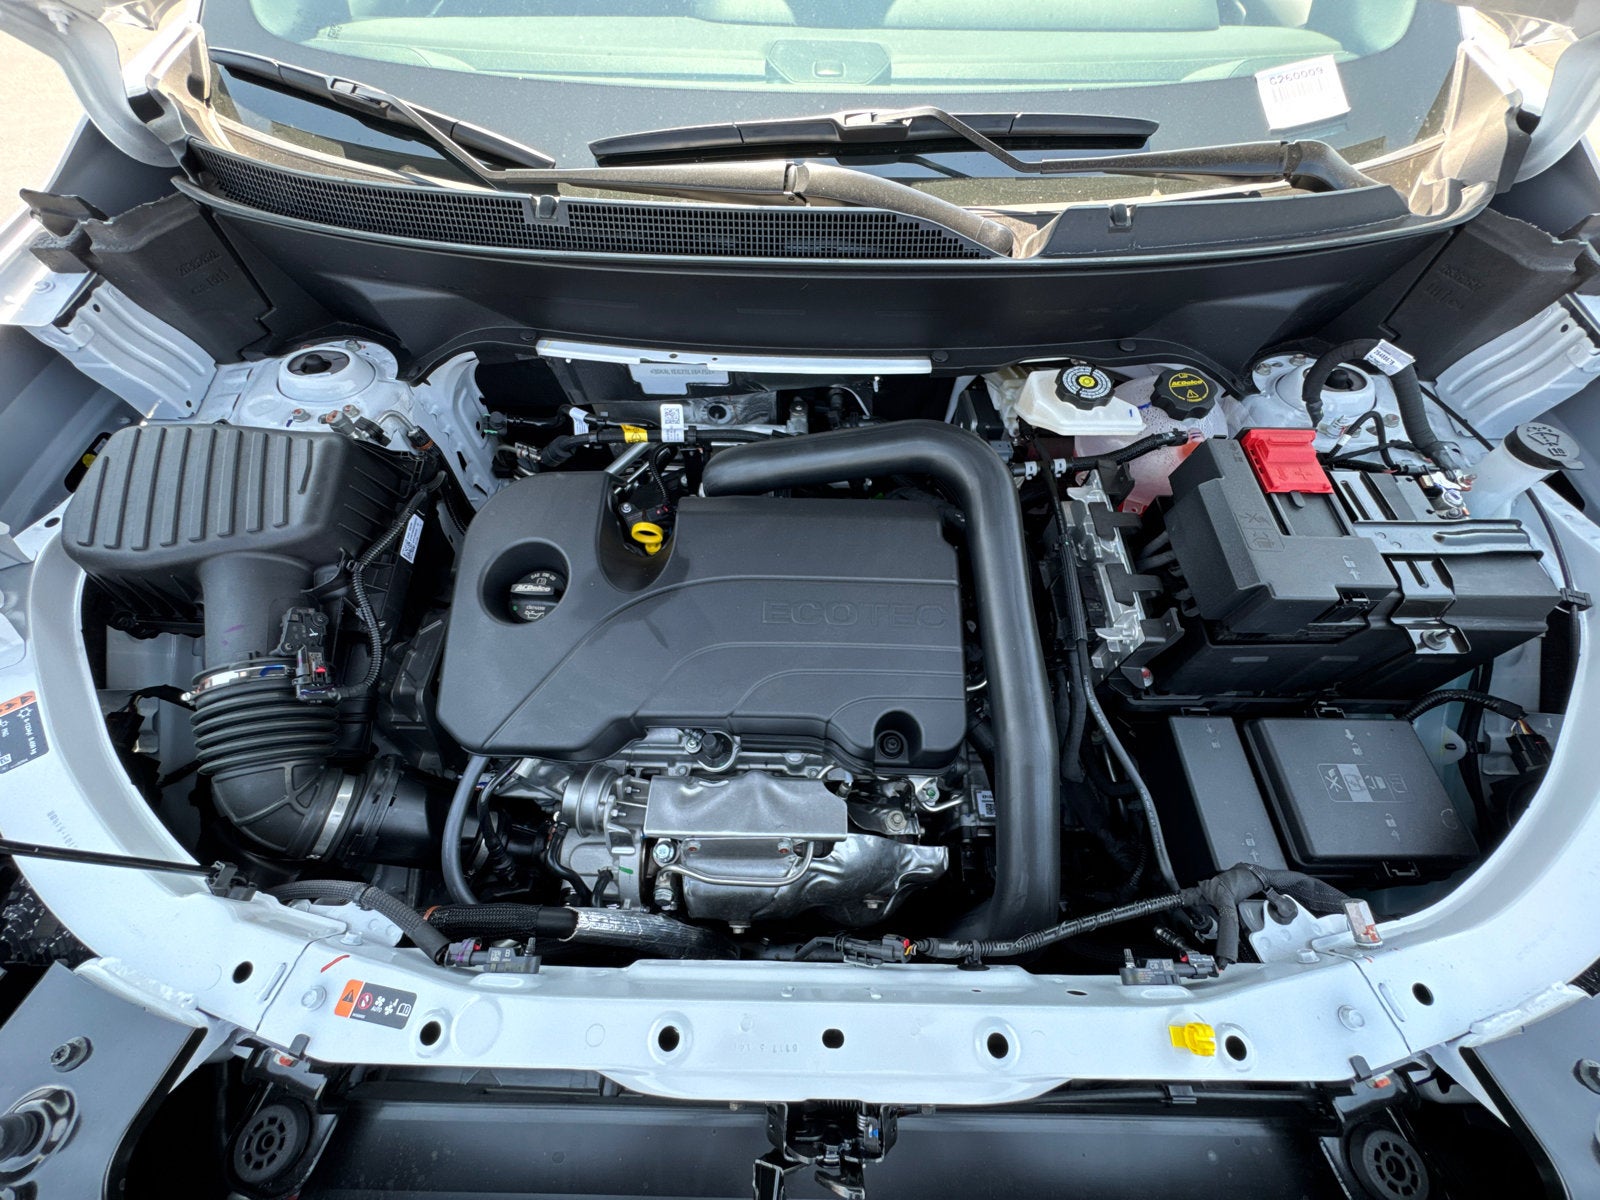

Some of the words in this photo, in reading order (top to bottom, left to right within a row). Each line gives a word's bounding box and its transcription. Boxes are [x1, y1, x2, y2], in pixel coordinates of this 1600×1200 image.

[1171, 379, 1204, 388] ACDelco
[514, 584, 551, 592] ACDelco
[762, 601, 948, 629] ECOTEC
